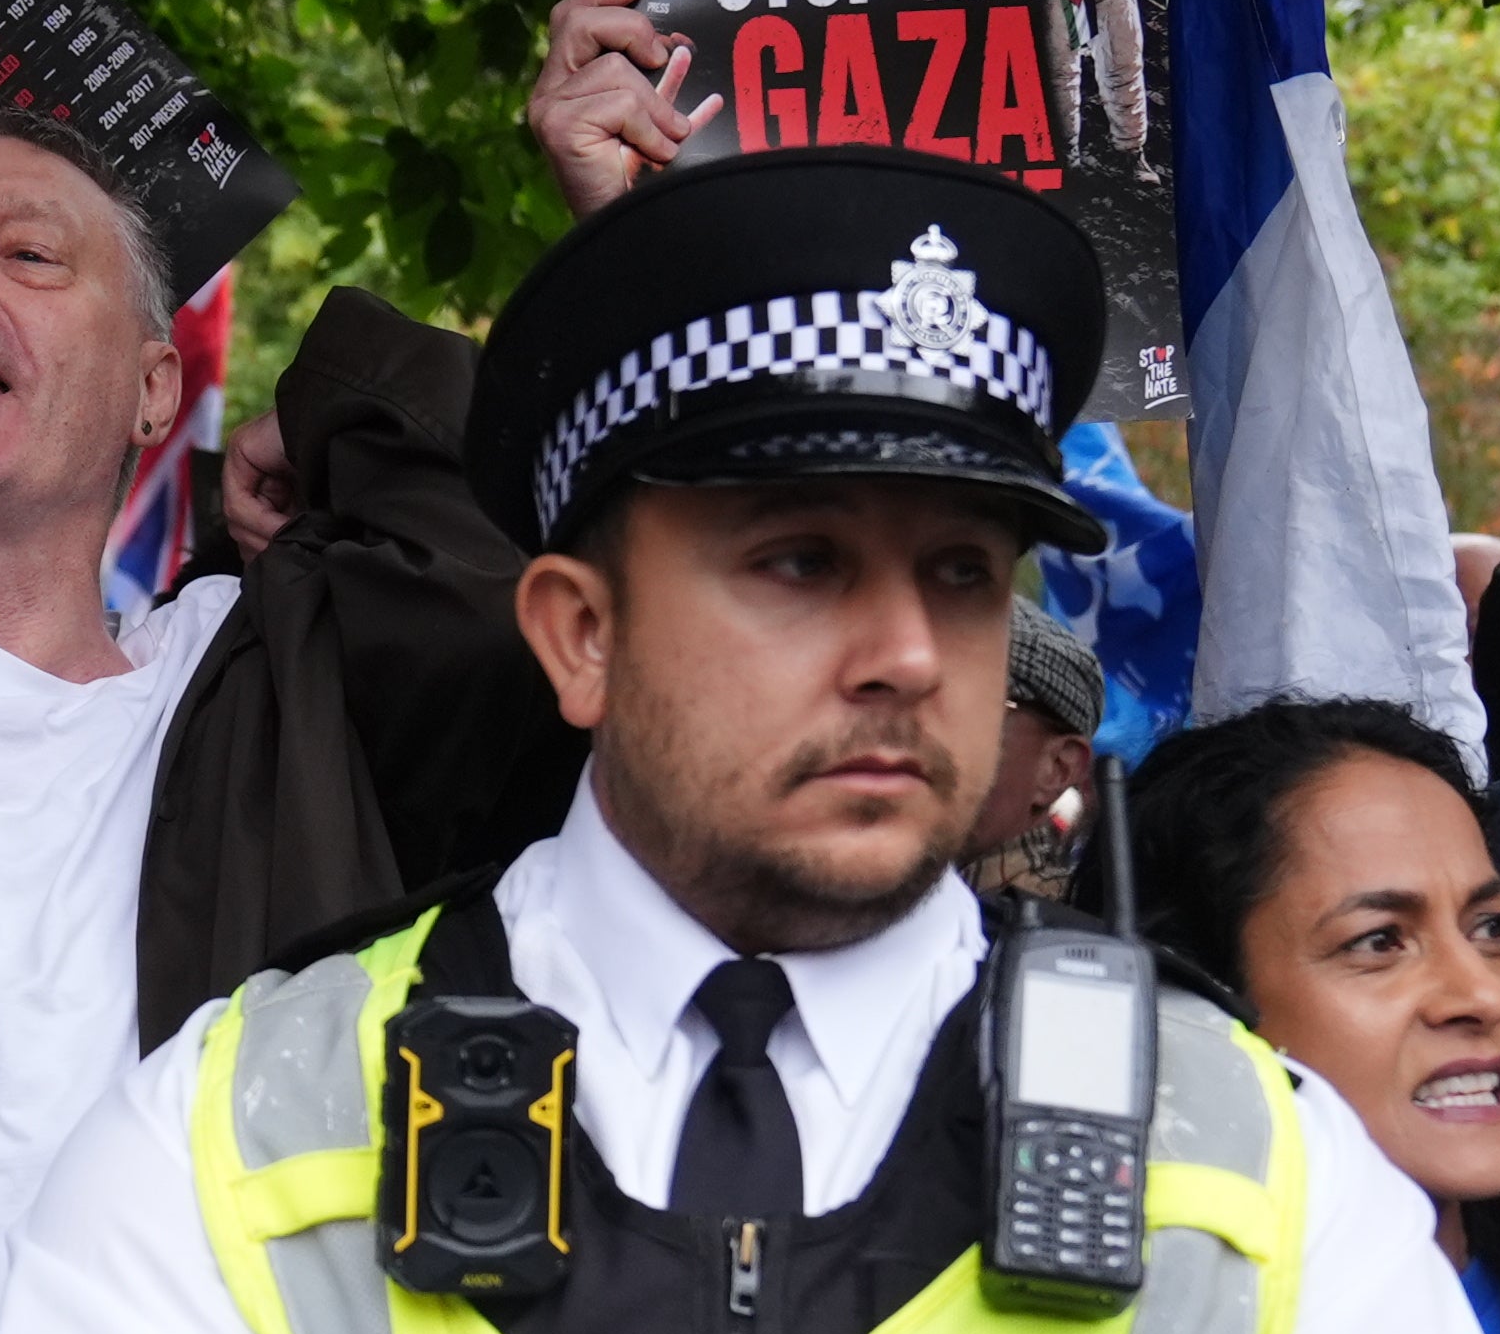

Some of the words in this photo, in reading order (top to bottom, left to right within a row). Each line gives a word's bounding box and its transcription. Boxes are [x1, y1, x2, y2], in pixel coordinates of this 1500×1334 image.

[43, 4, 73, 34] 1994
[646, 2, 670, 14] PRESS
[68, 27, 98, 57] 1995
[732, 5, 1055, 164] GAZA
[202, 136, 224, 163] THE
[203, 144, 236, 181] HATE
[1147, 362, 1173, 381] THE
[1145, 373, 1177, 399] HATE
